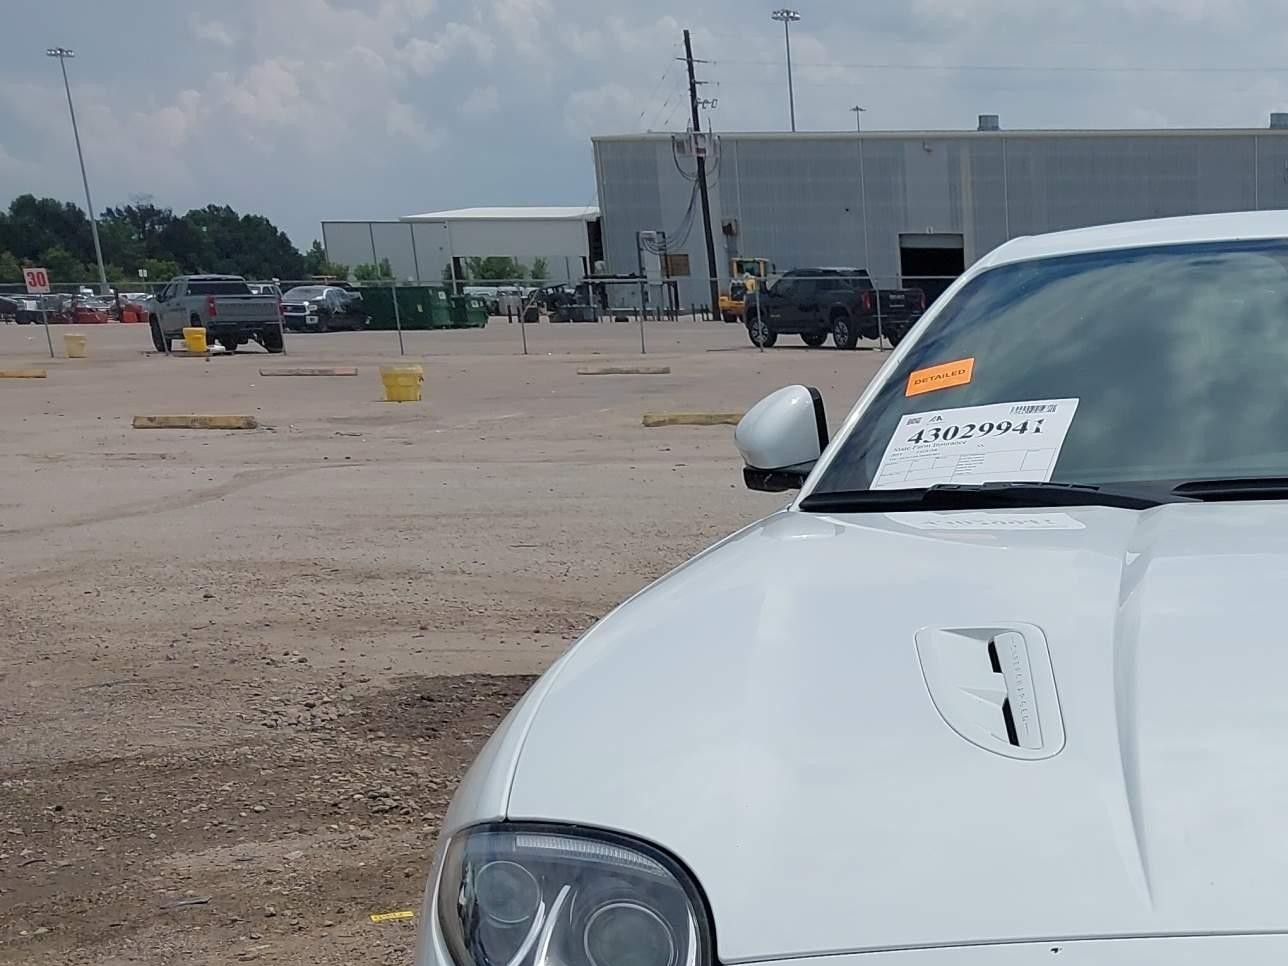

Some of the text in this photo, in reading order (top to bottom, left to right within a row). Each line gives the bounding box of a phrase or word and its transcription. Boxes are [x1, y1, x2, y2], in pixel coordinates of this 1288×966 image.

[27, 271, 46, 287] 30
[914, 368, 966, 385] DETAILED
[907, 418, 1046, 445] 43029941
